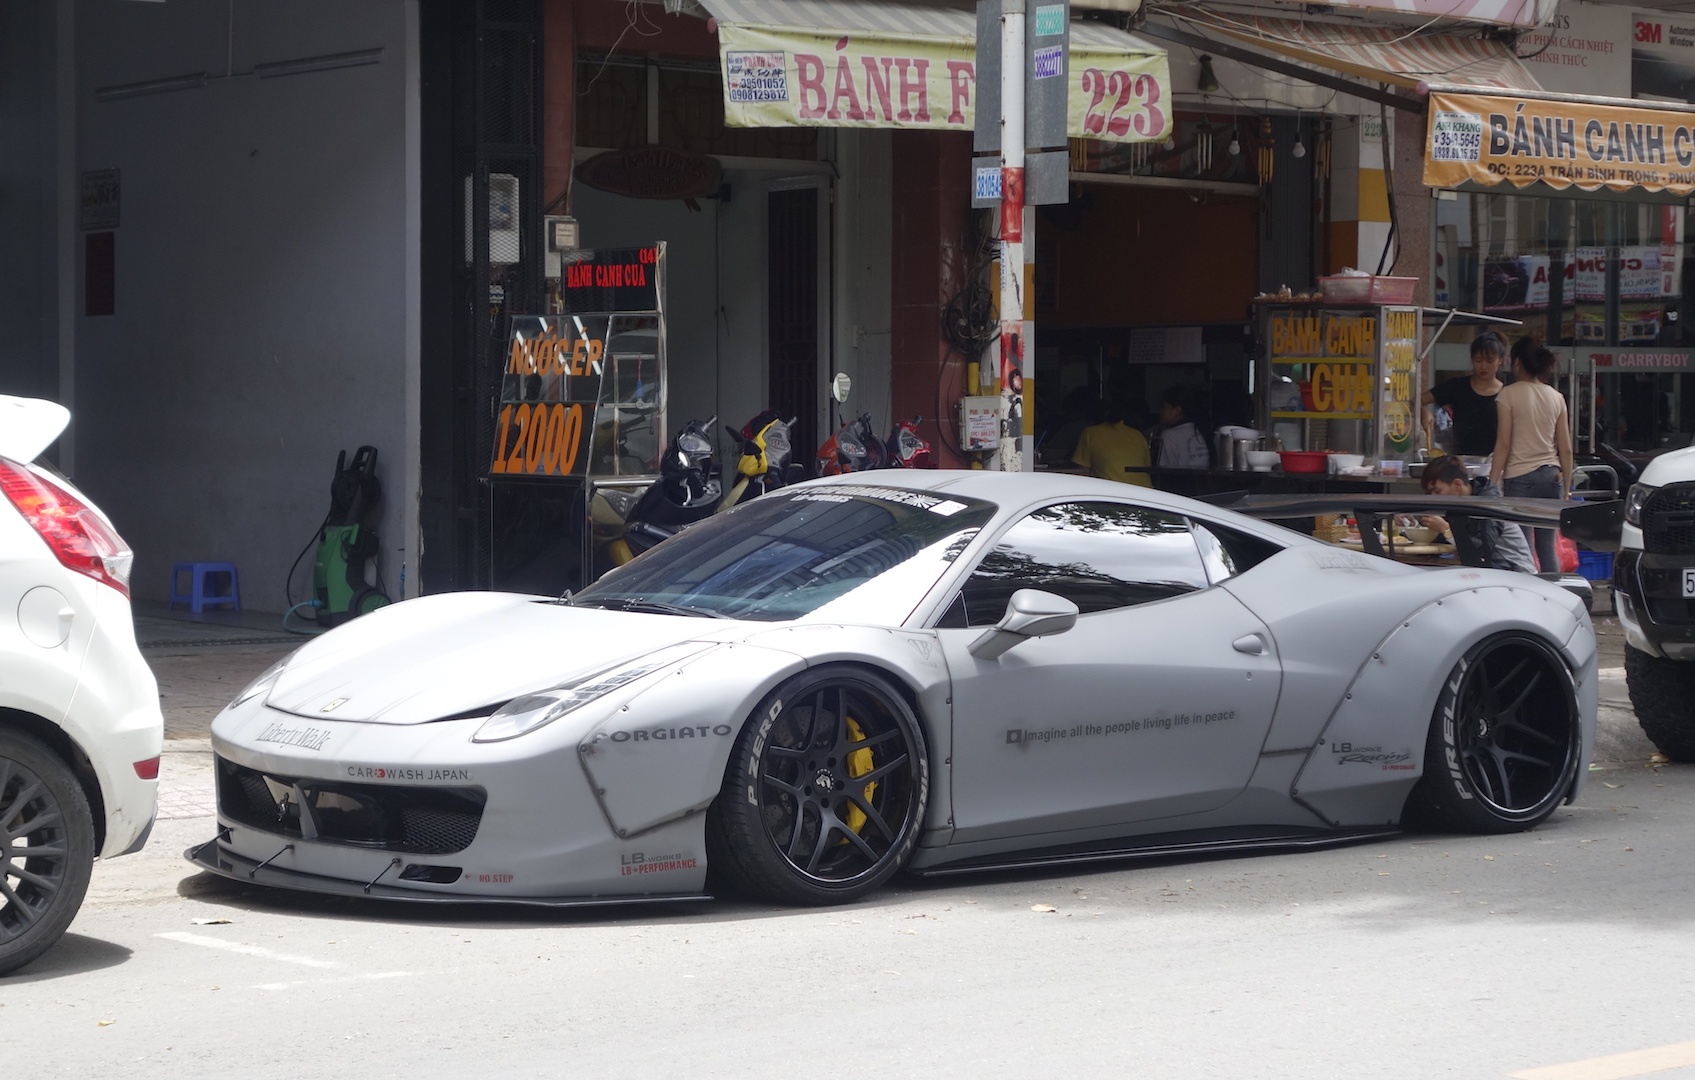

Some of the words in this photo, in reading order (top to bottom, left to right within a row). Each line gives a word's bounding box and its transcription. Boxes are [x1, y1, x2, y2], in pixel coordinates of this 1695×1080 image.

[1559, 36, 1585, 50] CÁCH
[1586, 40, 1614, 55] NHIỆT
[1634, 21, 1662, 44] 3M
[732, 89, 787, 100] 0908129812
[794, 36, 931, 122] BÁNH
[1081, 67, 1165, 138] 223
[1452, 122, 1481, 132] KHANG
[1489, 103, 1577, 159] BÁNH
[1584, 119, 1667, 165] CANH
[1514, 164, 1546, 177] 223A
[567, 257, 593, 288] BÁNH
[595, 264, 623, 287] CANH
[624, 264, 646, 287] CUA
[1273, 308, 1320, 355] BÁNH
[1326, 316, 1376, 355] CANH
[508, 326, 569, 376] NƯỚC
[570, 326, 604, 376] ÉP
[1617, 353, 1689, 367] CARRYBOY
[1311, 363, 1372, 411] CUA
[493, 403, 583, 476] 12000
[301, 727, 332, 751] Walk
[748, 699, 783, 779] ZERO
[1024, 728, 1067, 742] Imagine
[1070, 725, 1083, 737] all
[1085, 723, 1102, 736] the
[1105, 719, 1140, 736] people
[1143, 717, 1172, 730] living
[1174, 713, 1190, 726] life
[1193, 712, 1202, 724] in
[1205, 710, 1235, 725] peace
[1443, 656, 1473, 800] PIRELLI
[347, 766, 374, 778] CAR
[385, 768, 424, 780] WASH
[427, 769, 468, 781] JAPAN
[479, 874, 490, 883] NO
[492, 874, 514, 883] STEP
